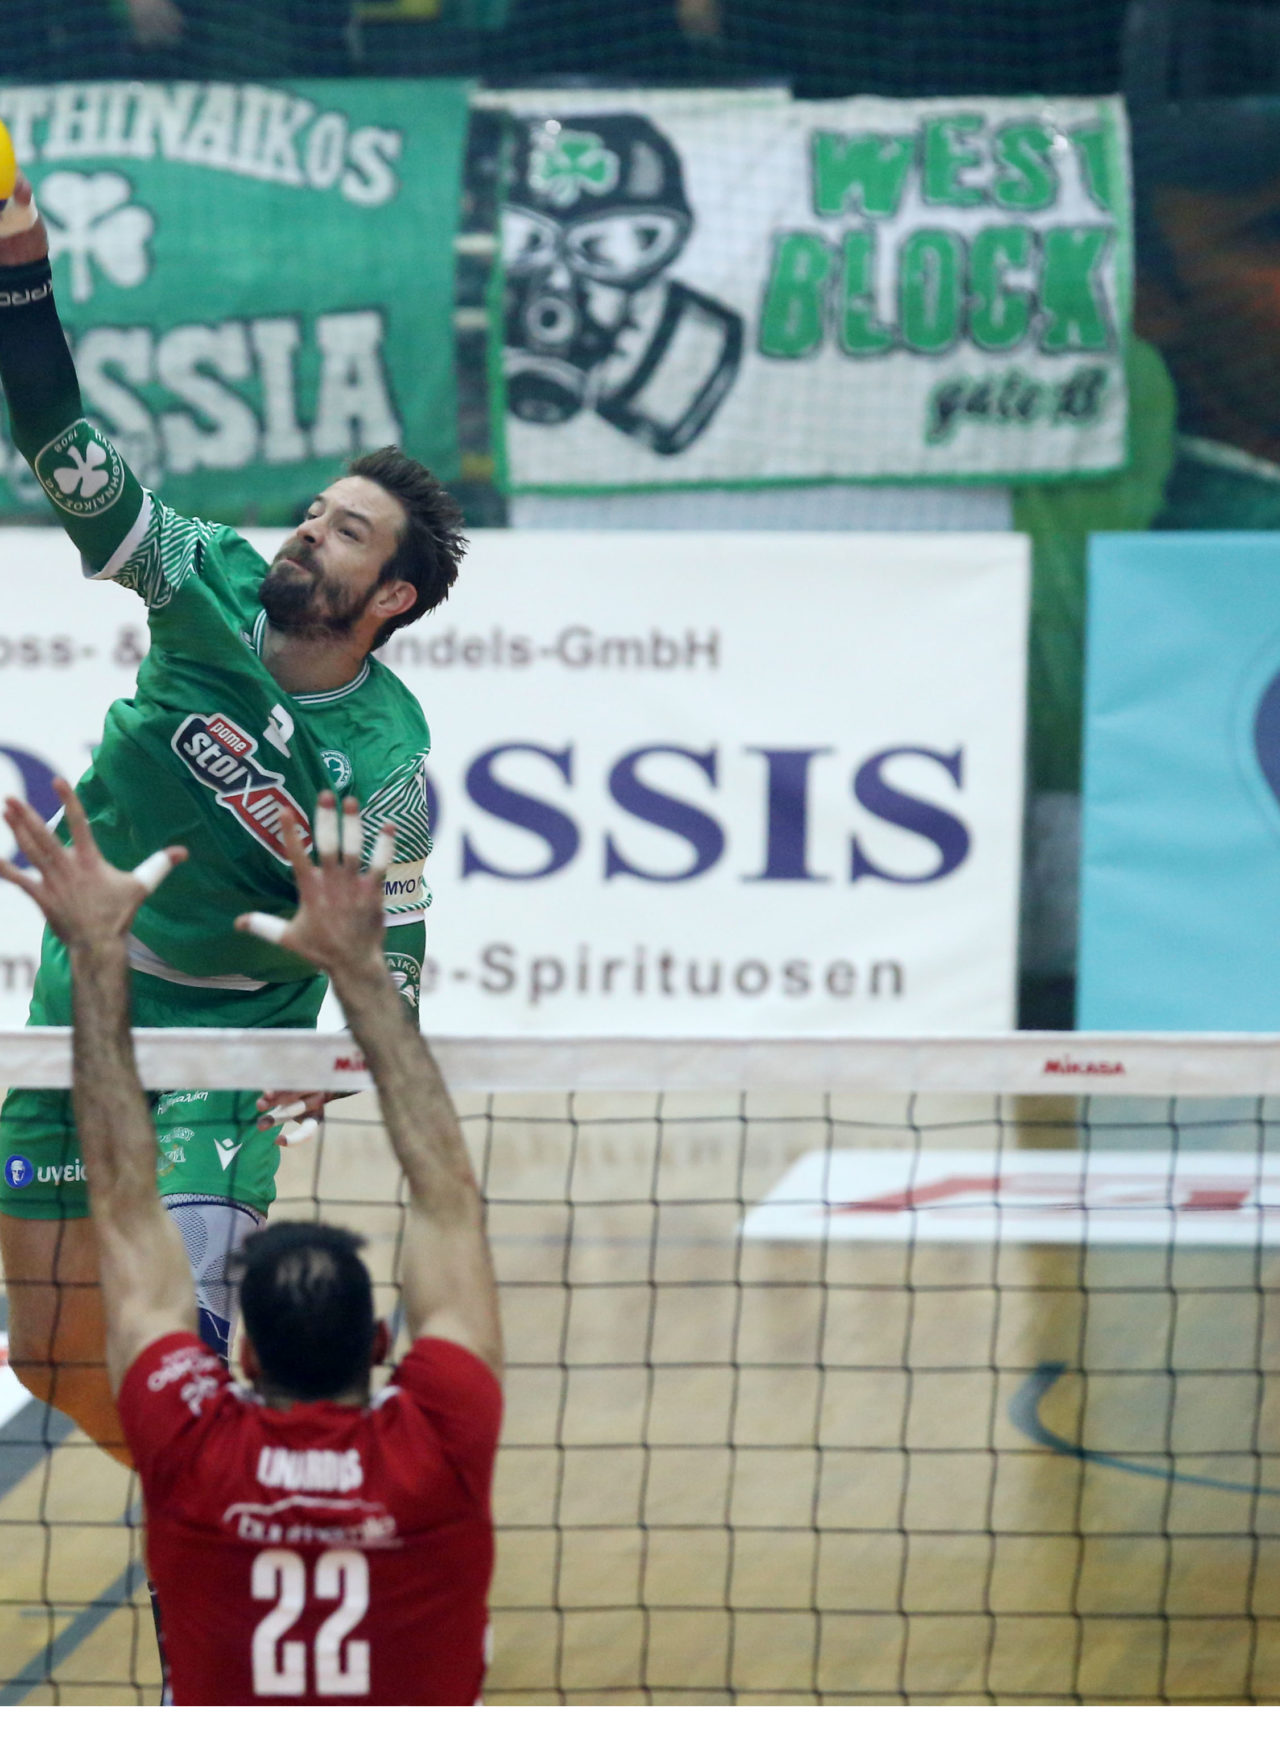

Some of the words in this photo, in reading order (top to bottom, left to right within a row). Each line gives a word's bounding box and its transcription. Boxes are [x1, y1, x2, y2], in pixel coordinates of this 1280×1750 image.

[757, 222, 1117, 358] BLOCK
[375, 624, 721, 671] ndels-GmbH
[209, 720, 248, 754] pame
[420, 943, 906, 1008] e-Spirituosen
[251, 1549, 372, 1697] 22
